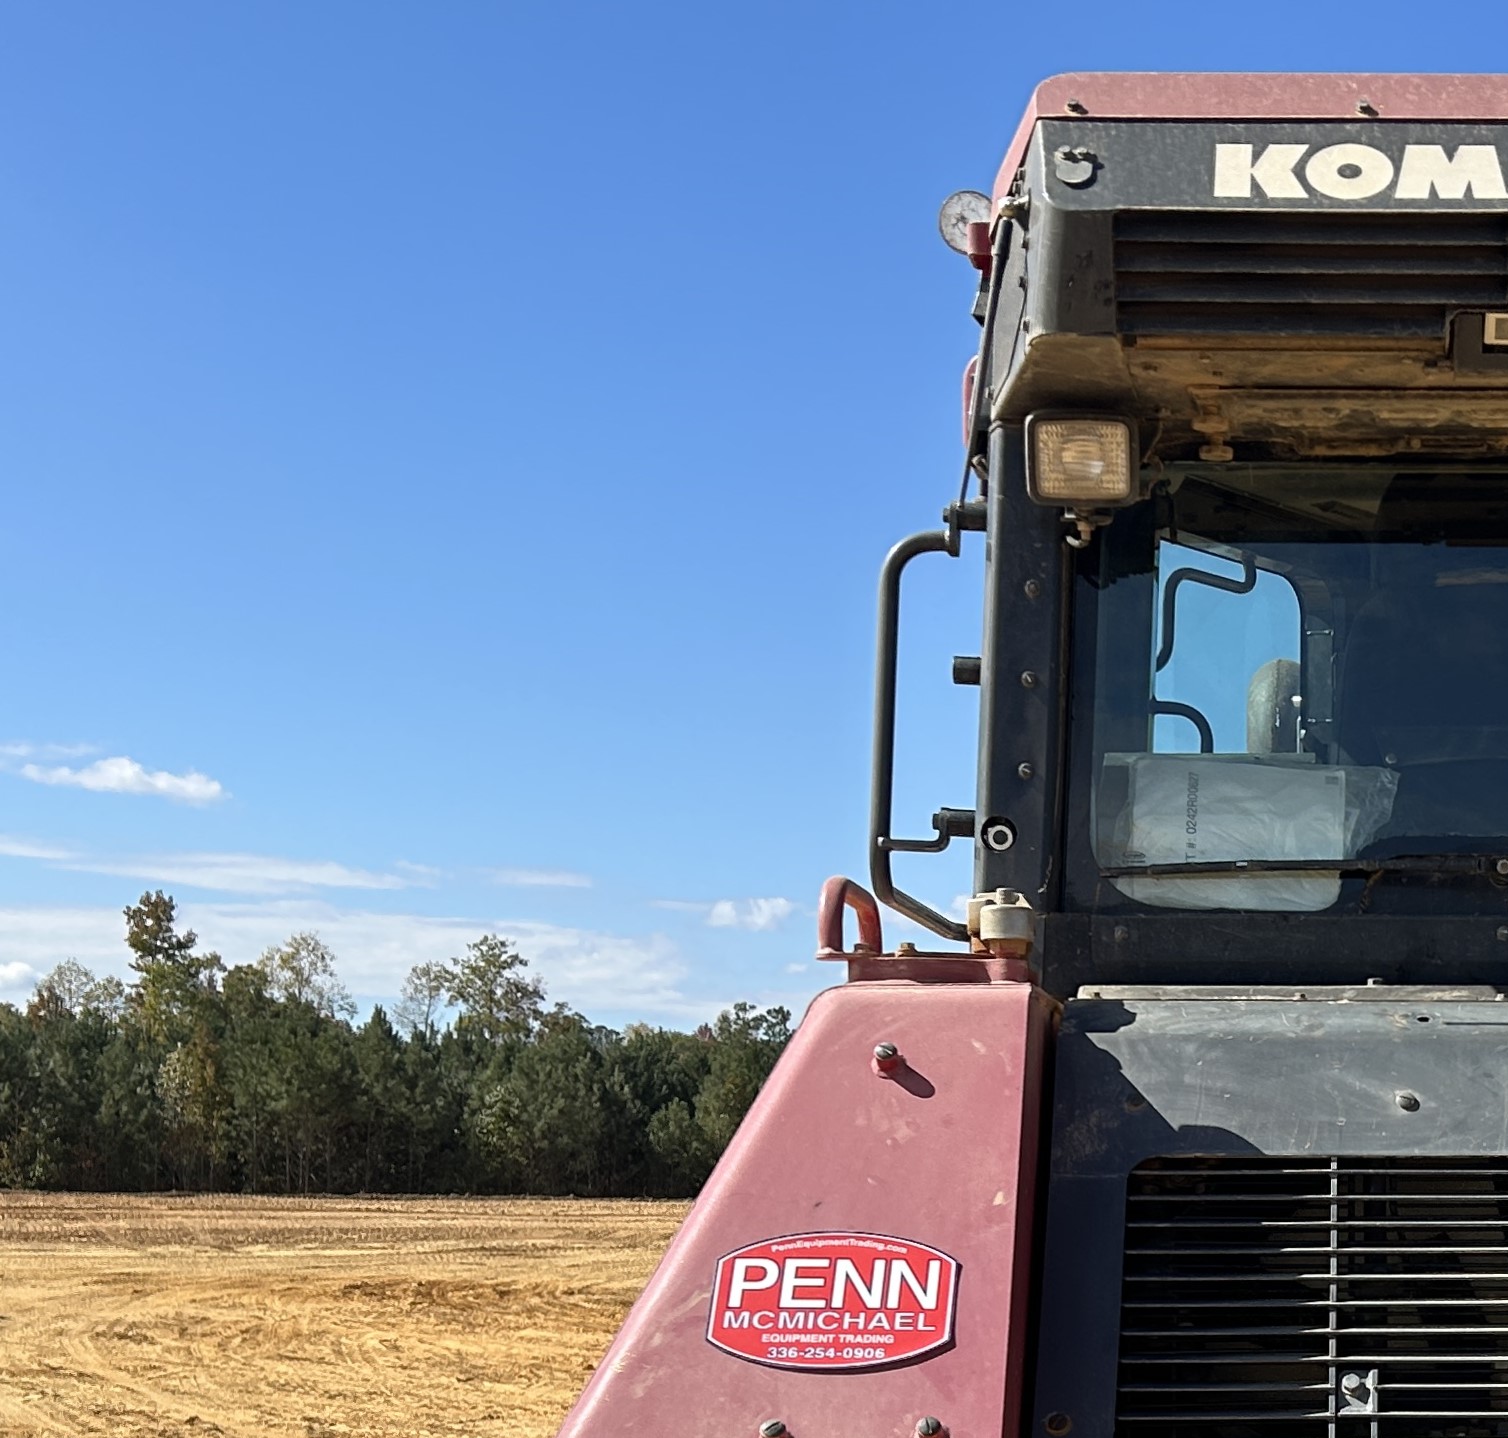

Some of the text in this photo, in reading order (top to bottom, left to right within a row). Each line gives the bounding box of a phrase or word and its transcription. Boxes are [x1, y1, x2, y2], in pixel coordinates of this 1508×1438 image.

[726, 1258, 942, 1310] PENN
[722, 1311, 936, 1331] MCMICHAEL
[761, 1333, 895, 1345] EQUIPMENT TRADING
[766, 1347, 886, 1359] 336-254-0906
